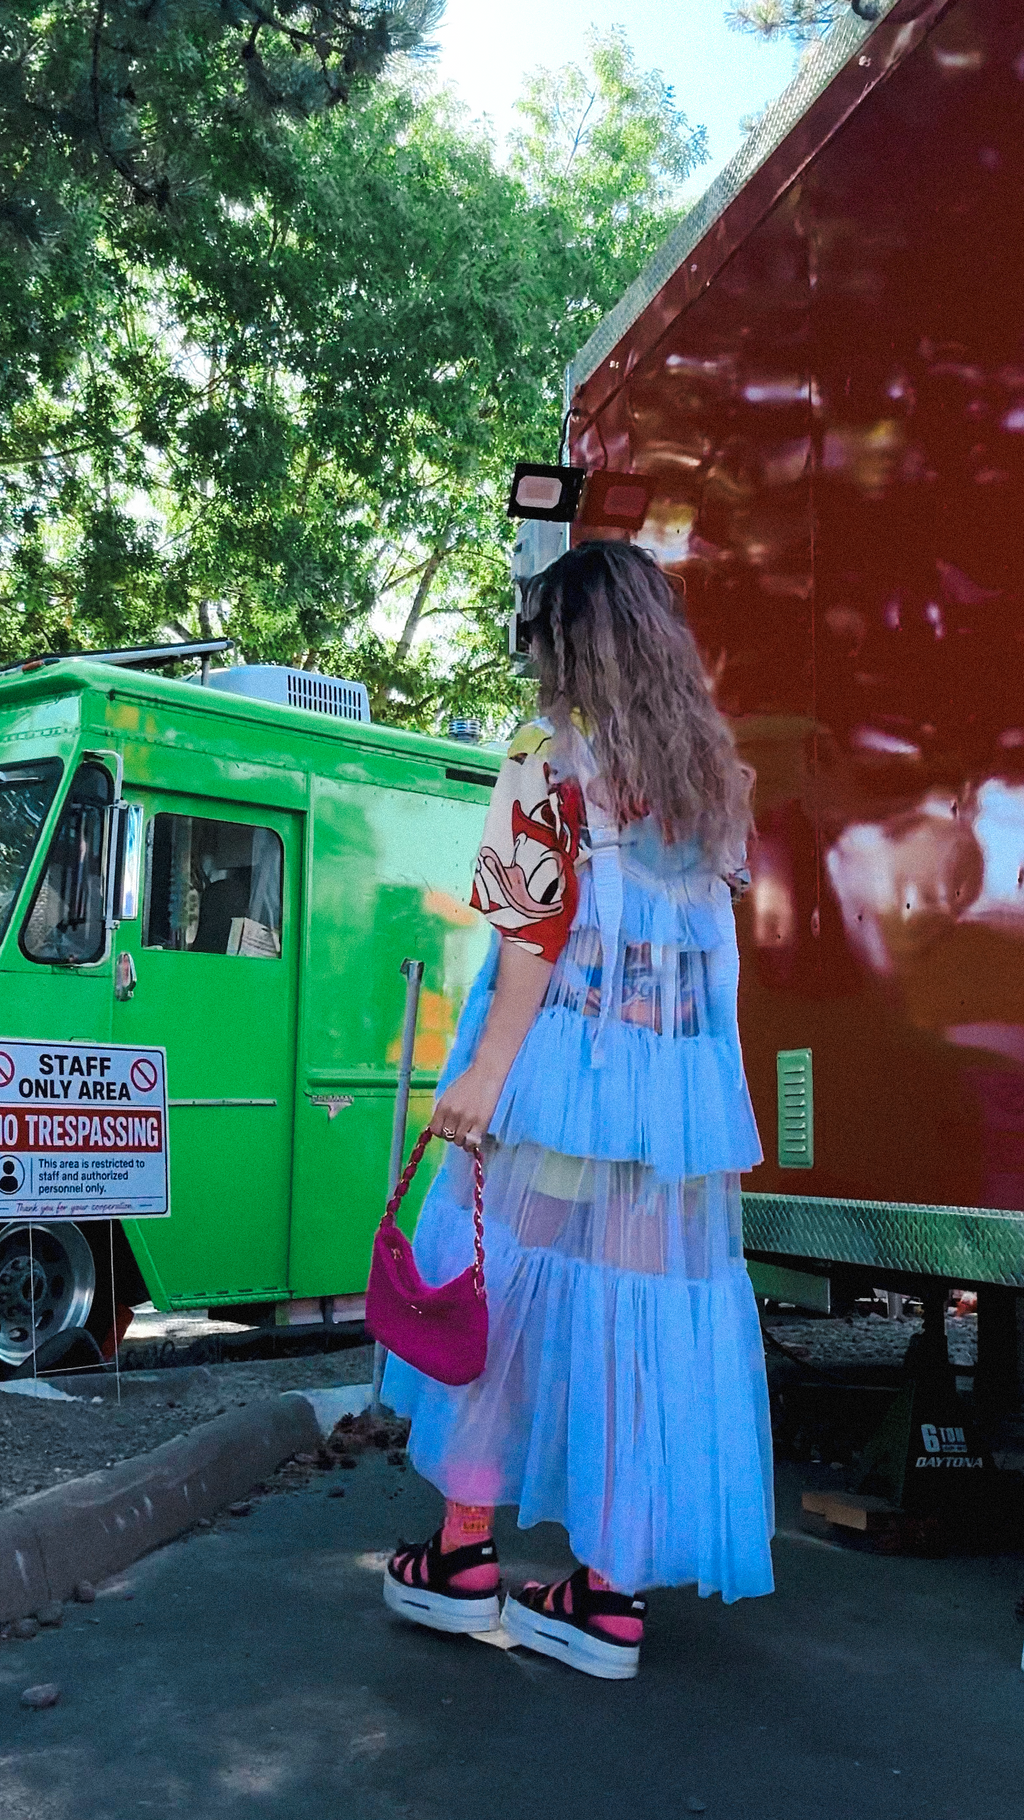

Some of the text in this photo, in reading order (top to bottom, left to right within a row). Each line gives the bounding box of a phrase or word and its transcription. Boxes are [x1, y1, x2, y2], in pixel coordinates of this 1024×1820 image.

[39, 1054, 111, 1077] STAFF
[19, 1078, 131, 1101] ONLY AREA
[25, 1114, 159, 1147] TRESPASSING
[38, 1158, 145, 1169] This area is restricted to
[38, 1170, 129, 1181] staff and authorized
[38, 1183, 107, 1195] personnel only.
[16, 1202, 38, 1213] Thank
[40, 1205, 54, 1216] you
[56, 1201, 67, 1214] for
[70, 1204, 88, 1215] your
[921, 1424, 940, 1452] 6
[915, 1456, 983, 1468] DAYTONA
